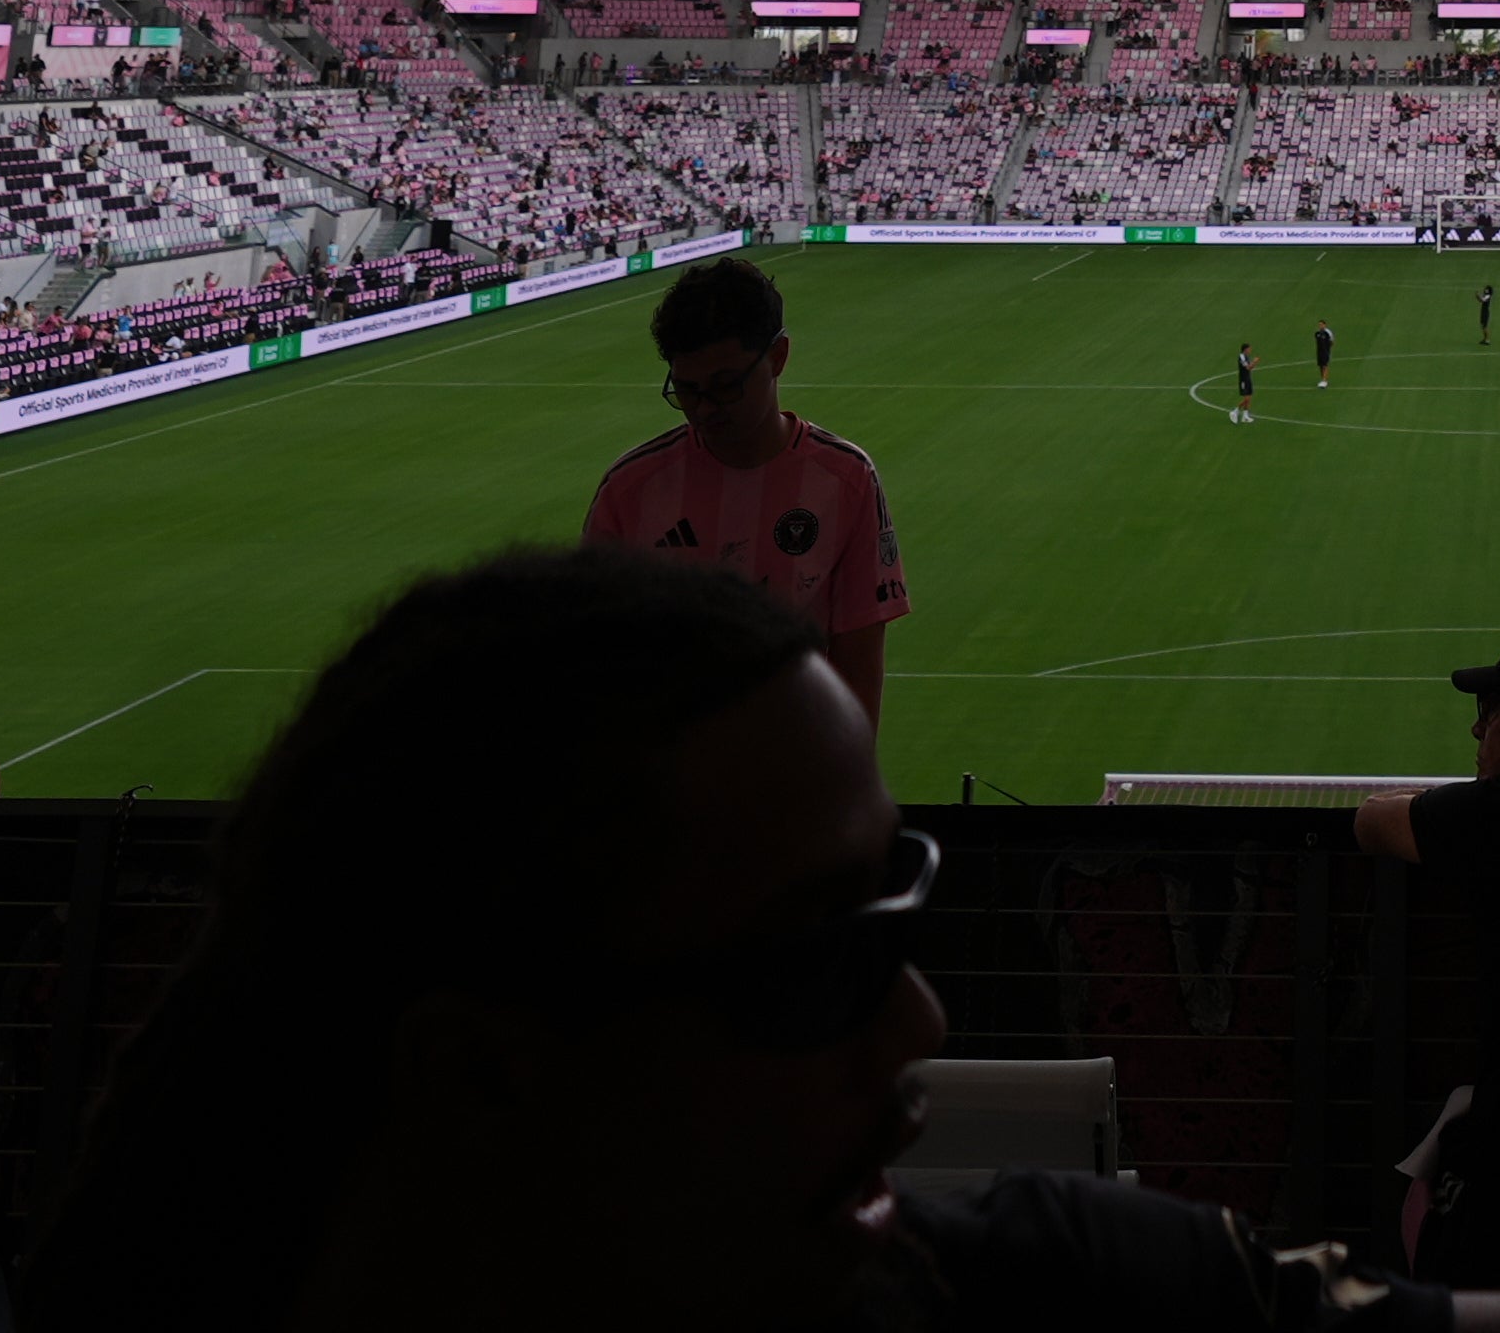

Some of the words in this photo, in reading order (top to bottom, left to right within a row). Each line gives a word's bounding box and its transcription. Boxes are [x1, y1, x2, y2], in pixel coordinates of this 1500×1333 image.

[906, 229, 934, 239] Sports
[936, 229, 979, 238] Medicine
[980, 229, 1018, 238] Provider
[1255, 230, 1284, 241] Sports
[1287, 230, 1328, 239] Medicine
[1331, 230, 1369, 239] Provider
[19, 395, 54, 418] Official
[55, 387, 85, 412] Sports
[86, 379, 127, 402] Medicine
[128, 372, 163, 392] Provider
[164, 370, 172, 383] of
[173, 365, 192, 381] Inter
[194, 360, 218, 377] Miami
[219, 356, 229, 369] CF
